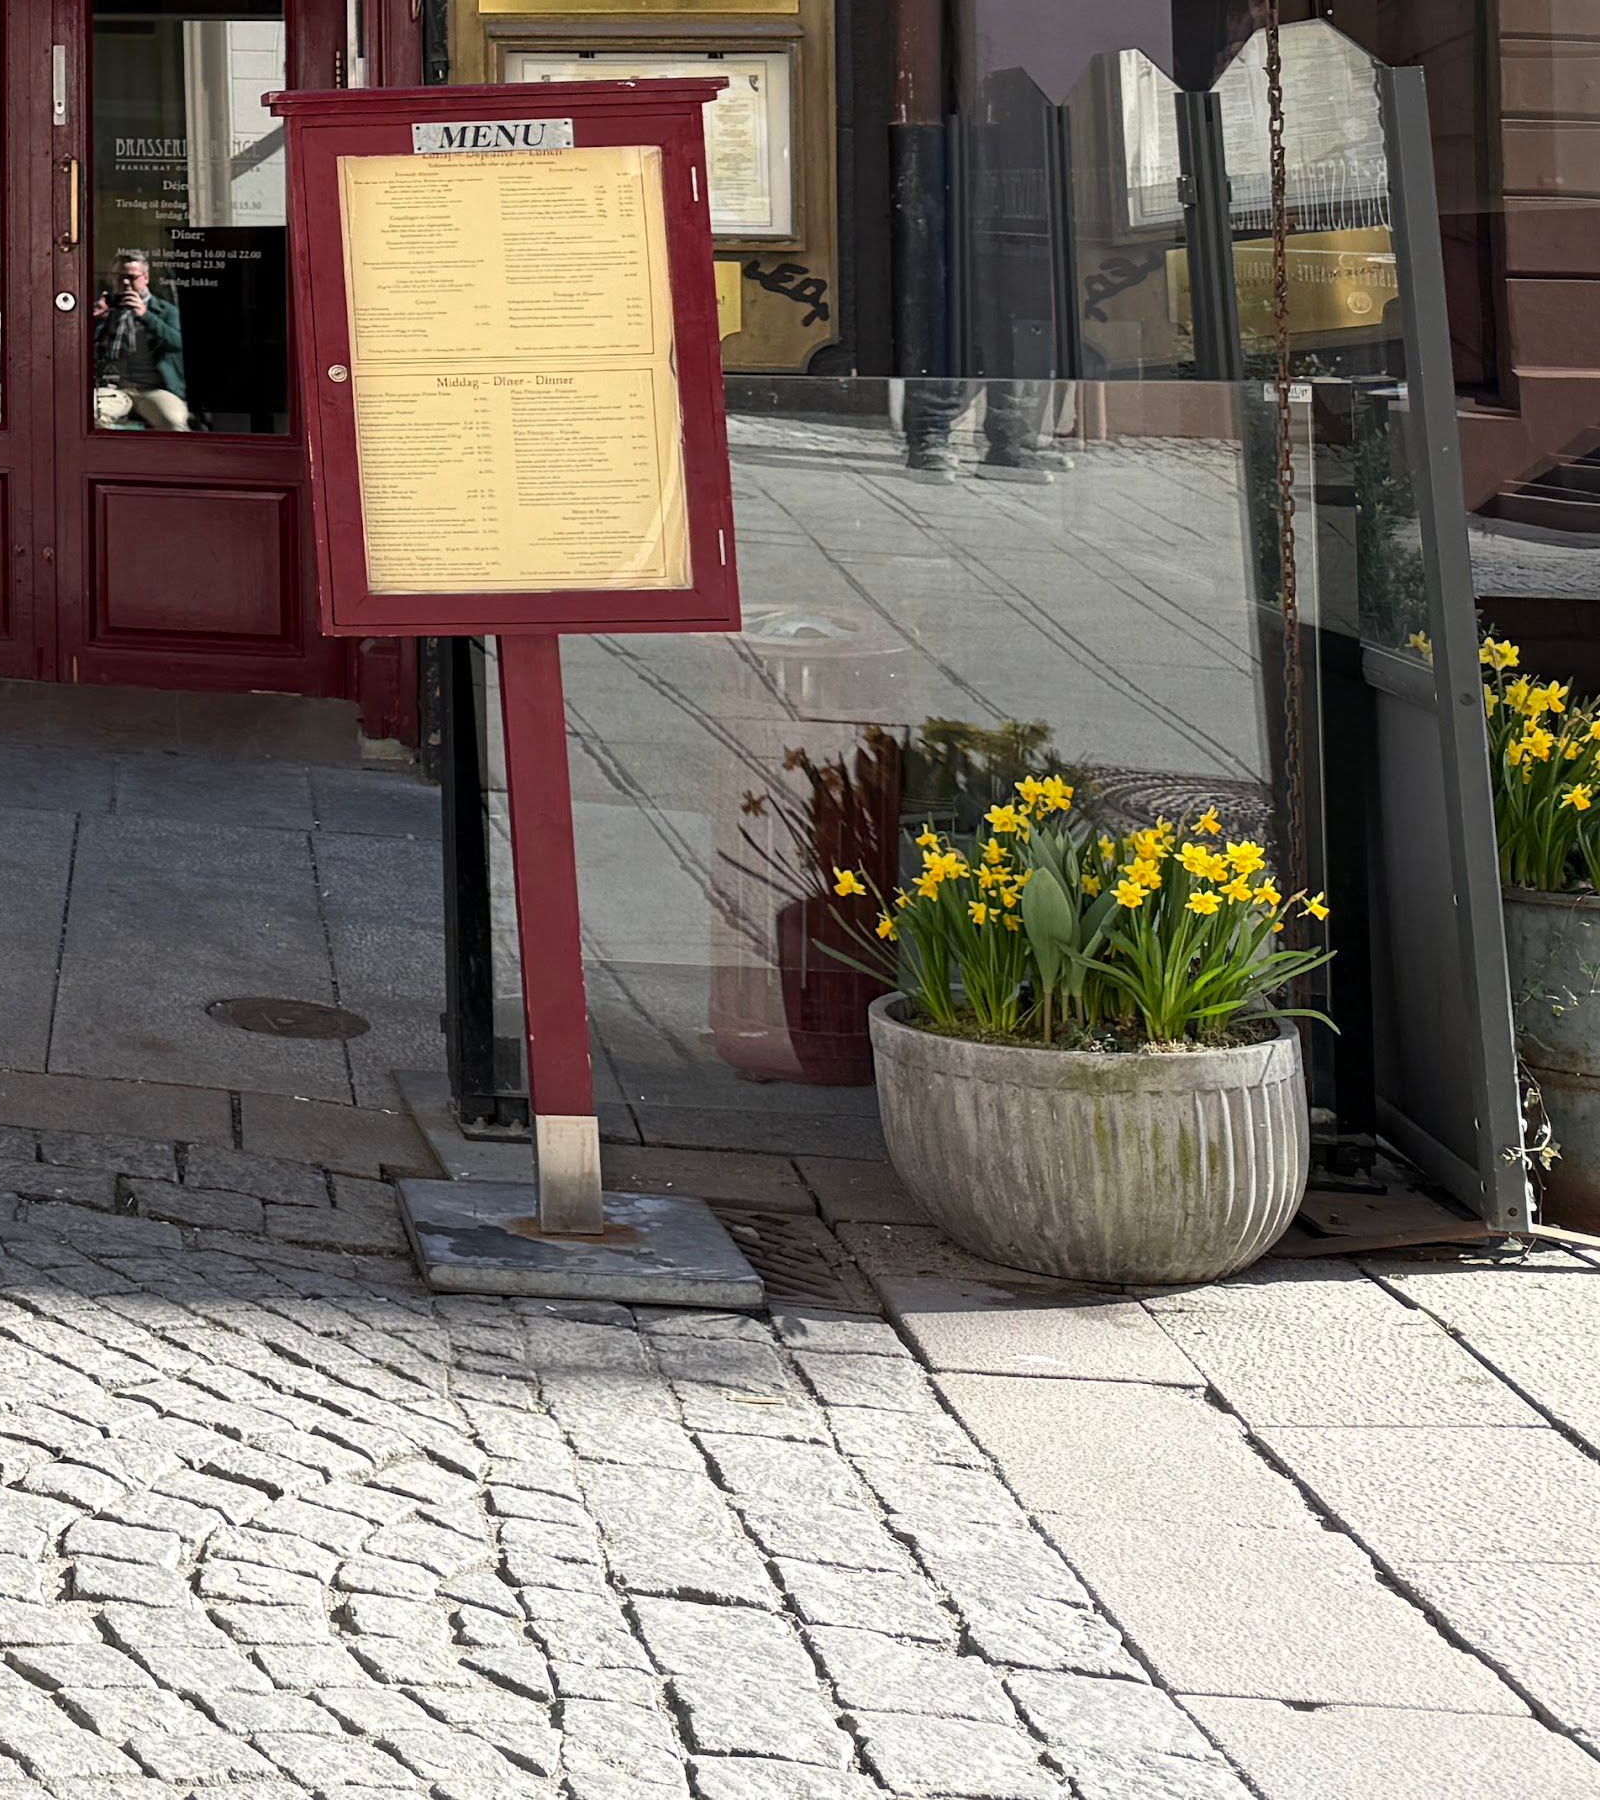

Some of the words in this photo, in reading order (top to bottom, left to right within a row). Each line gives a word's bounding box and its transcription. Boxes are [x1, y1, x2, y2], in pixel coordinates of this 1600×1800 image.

[438, 123, 547, 148] MENU
[115, 138, 192, 157] BRASSERI
[116, 199, 148, 210] Tirsdag
[437, 377, 480, 390] Middag
[535, 375, 575, 385] Dinner
